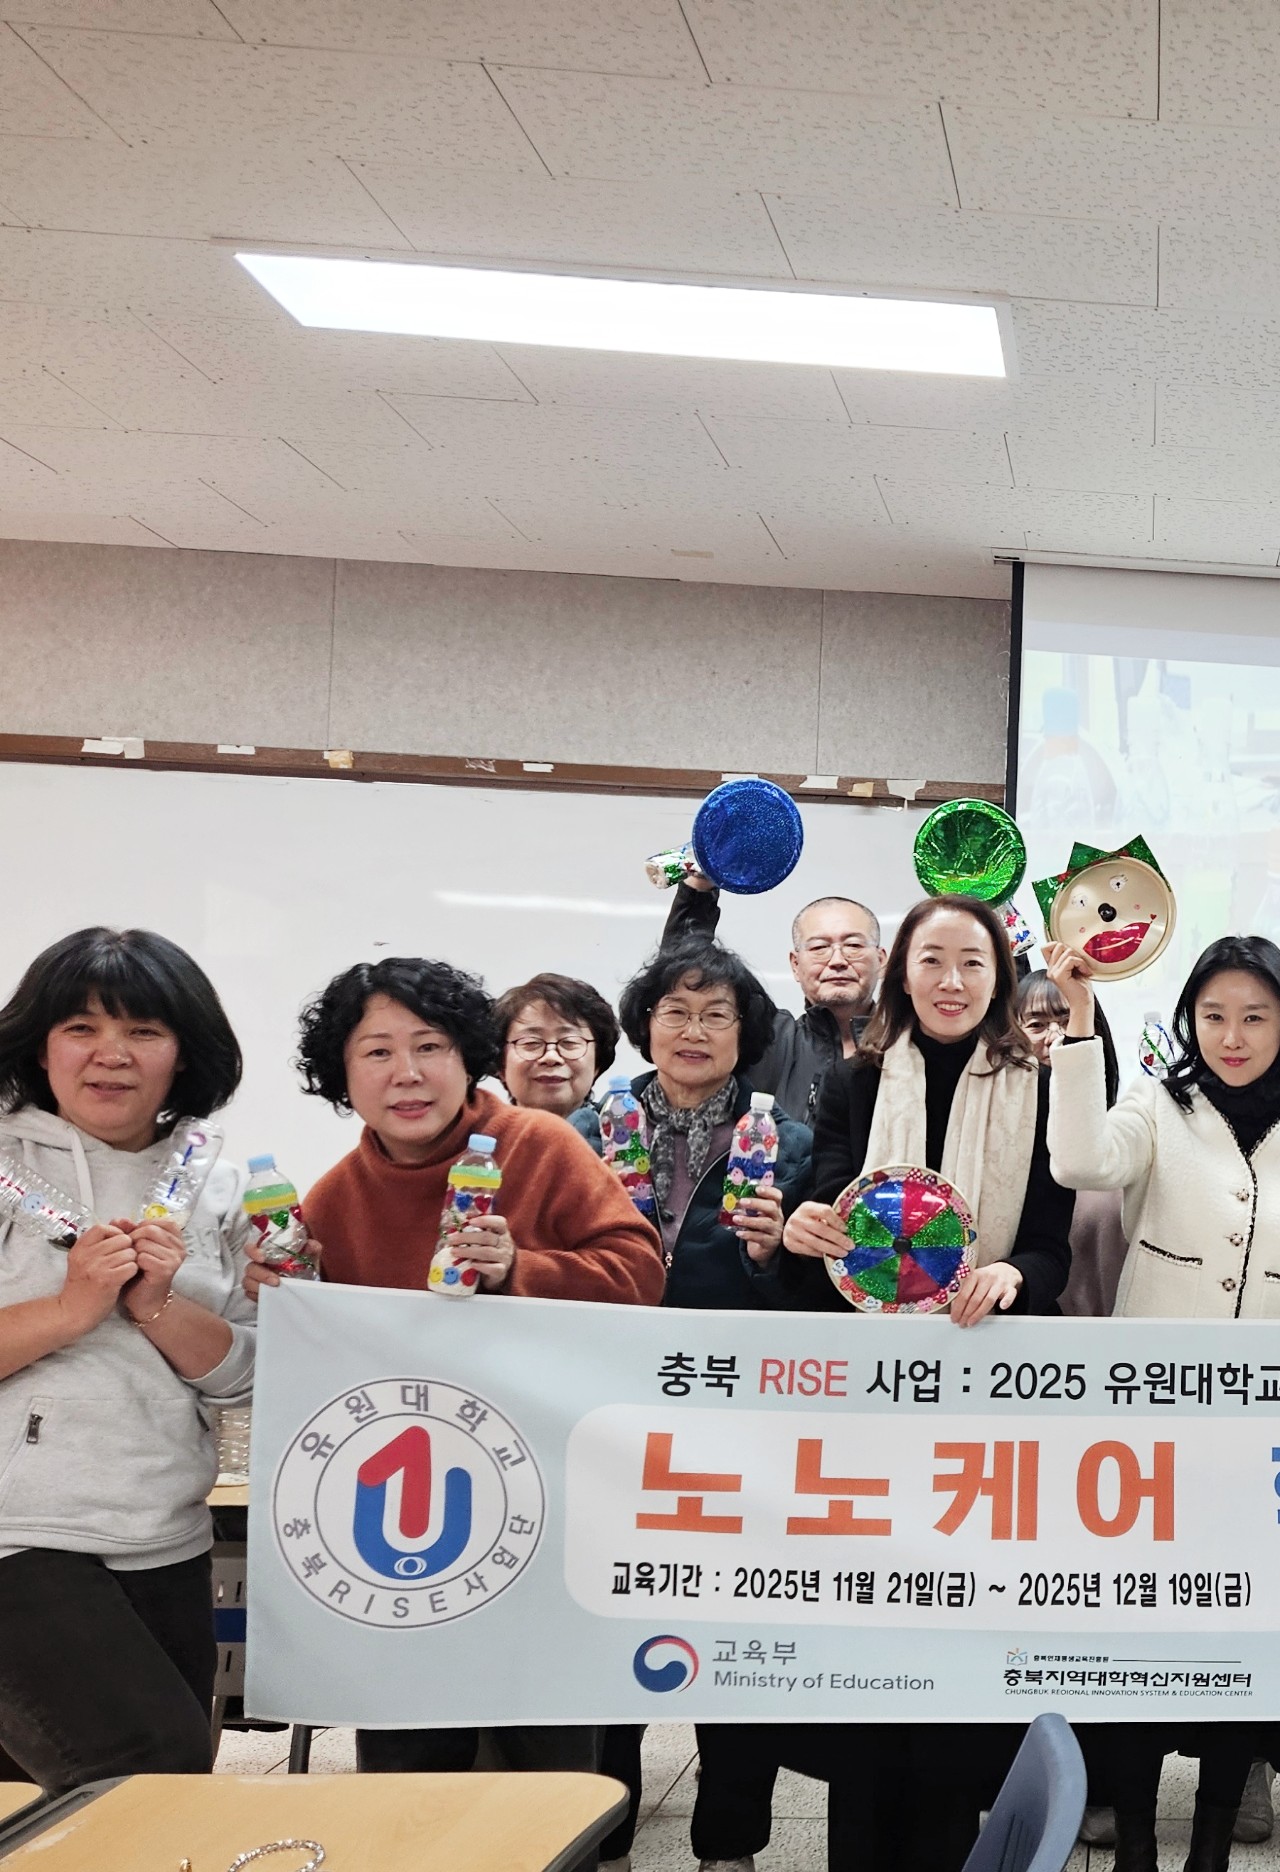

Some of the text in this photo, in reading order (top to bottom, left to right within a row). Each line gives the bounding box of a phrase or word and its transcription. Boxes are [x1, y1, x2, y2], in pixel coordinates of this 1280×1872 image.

[657, 1352, 741, 1398] 충북
[759, 1358, 849, 1397] RISE
[866, 1359, 942, 1404] 사업
[989, 1361, 1087, 1401] 2025
[301, 1383, 529, 1471] 유원대학교
[635, 1432, 1176, 1541] 노노케어
[282, 1513, 536, 1620] 충북RISE사업단
[611, 1562, 702, 1599] 교육기간
[733, 1567, 821, 1603] 2025년
[833, 1571, 876, 1605] 11월
[887, 1570, 976, 1608] 21일(금)
[1018, 1571, 1101, 1609] 2025년
[1112, 1571, 1157, 1608] 12월
[1168, 1571, 1252, 1608] 19일(금)
[712, 1639, 798, 1666] 교육부
[714, 1671, 935, 1693] Ministry of Education
[1003, 1669, 1252, 1688] 충북지역대학혁신지원센터
[1004, 1688, 1049, 1696] CHUNGBUK
[1091, 1689, 1139, 1697] INNOVATION
[1140, 1689, 1170, 1697] SYSTEM
[1179, 1689, 1223, 1697] EDUCATION
[1224, 1690, 1253, 1698] CENTER
